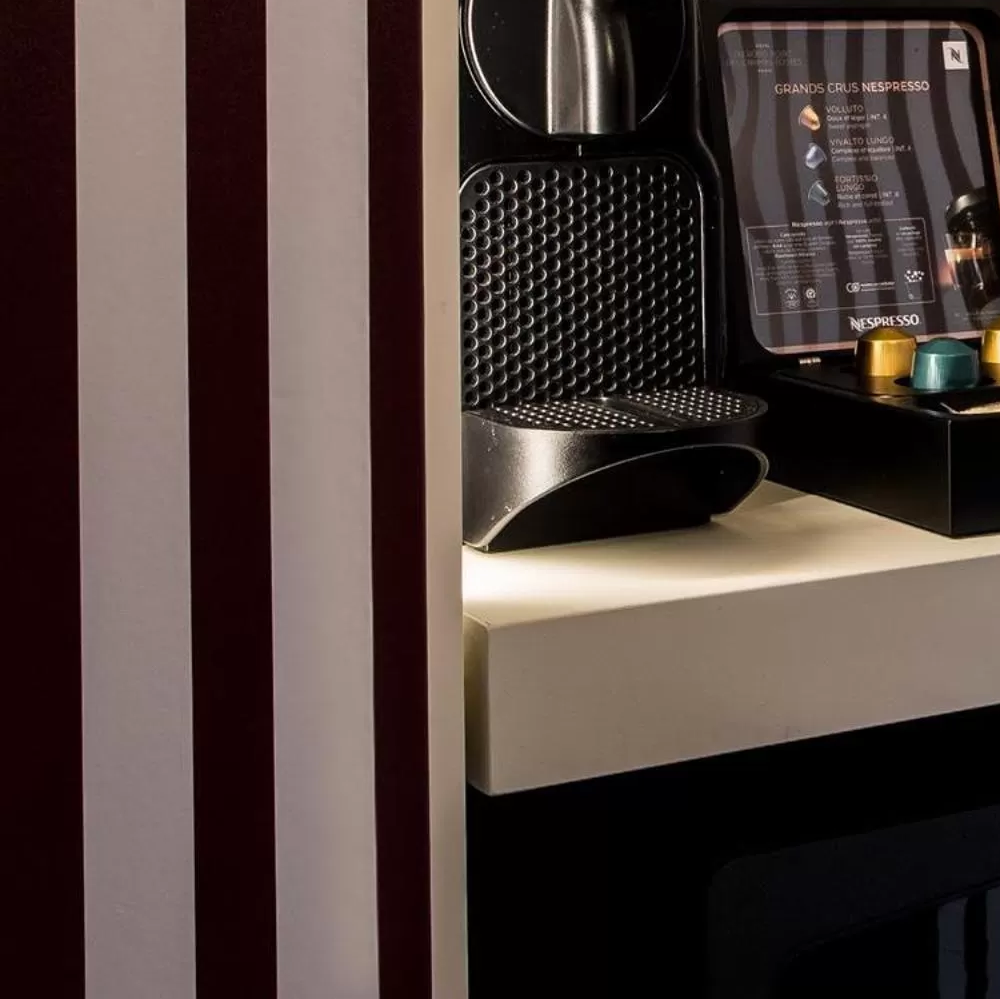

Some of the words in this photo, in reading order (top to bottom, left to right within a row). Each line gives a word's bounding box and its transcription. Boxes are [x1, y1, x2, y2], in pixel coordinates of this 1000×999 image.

[774, 82, 825, 95] GRANDS
[826, 81, 860, 94] CRUS
[861, 79, 930, 93] NESPRESSO
[825, 104, 864, 114] VOLLUTO
[830, 137, 864, 146] VIVALTO
[865, 135, 895, 144] LUNGO
[848, 313, 920, 332] NESPRESSO
